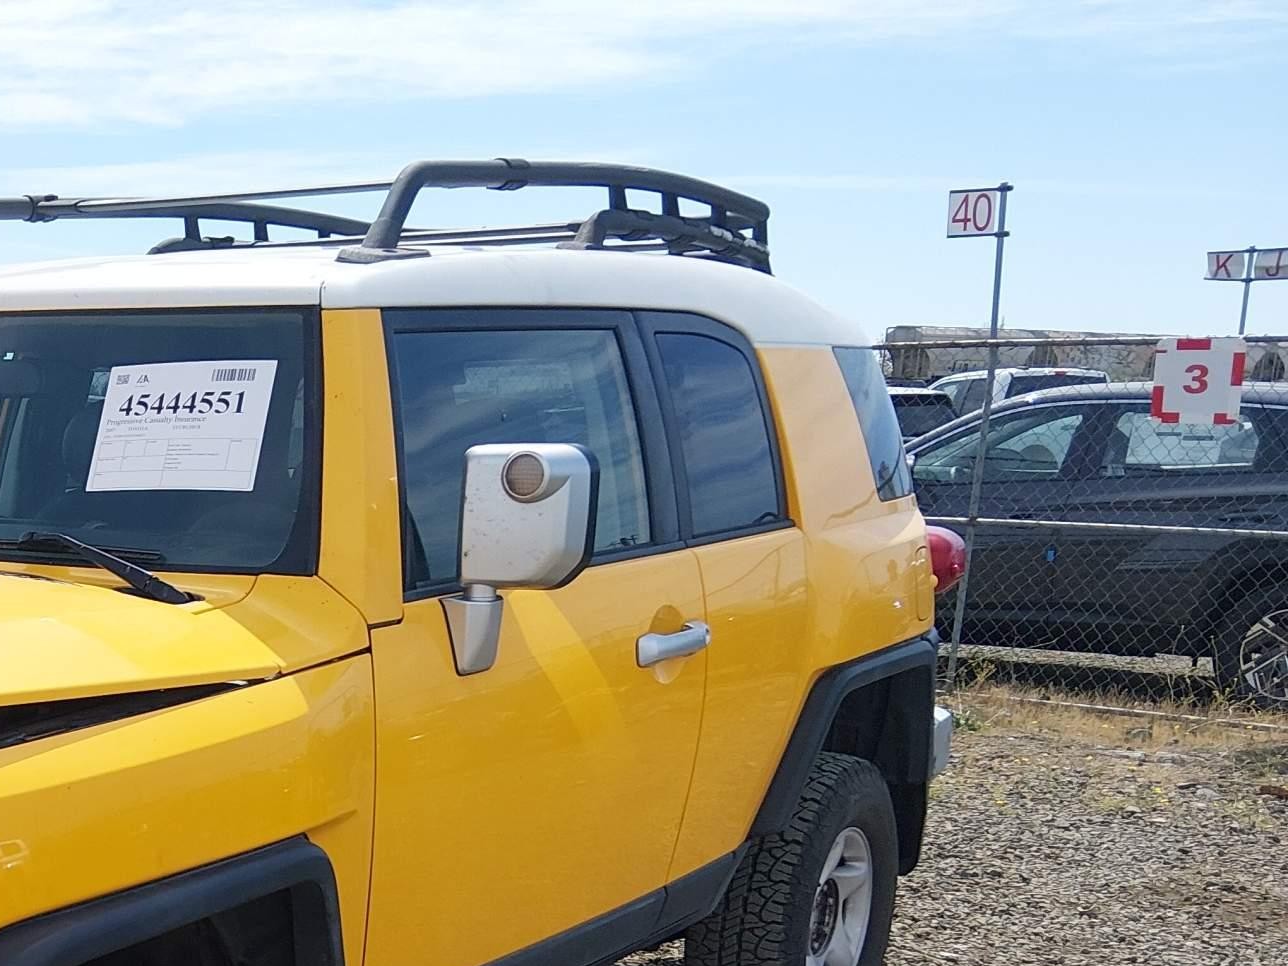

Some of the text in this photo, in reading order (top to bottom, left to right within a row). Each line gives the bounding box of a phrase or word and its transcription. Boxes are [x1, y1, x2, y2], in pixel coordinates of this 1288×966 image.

[951, 193, 992, 231] 40
[1213, 254, 1234, 278] K
[1265, 251, 1283, 276] J
[1182, 364, 1209, 394] 3
[118, 391, 246, 416] 45444551
[106, 415, 207, 427] Progressive Casualty Insurance
